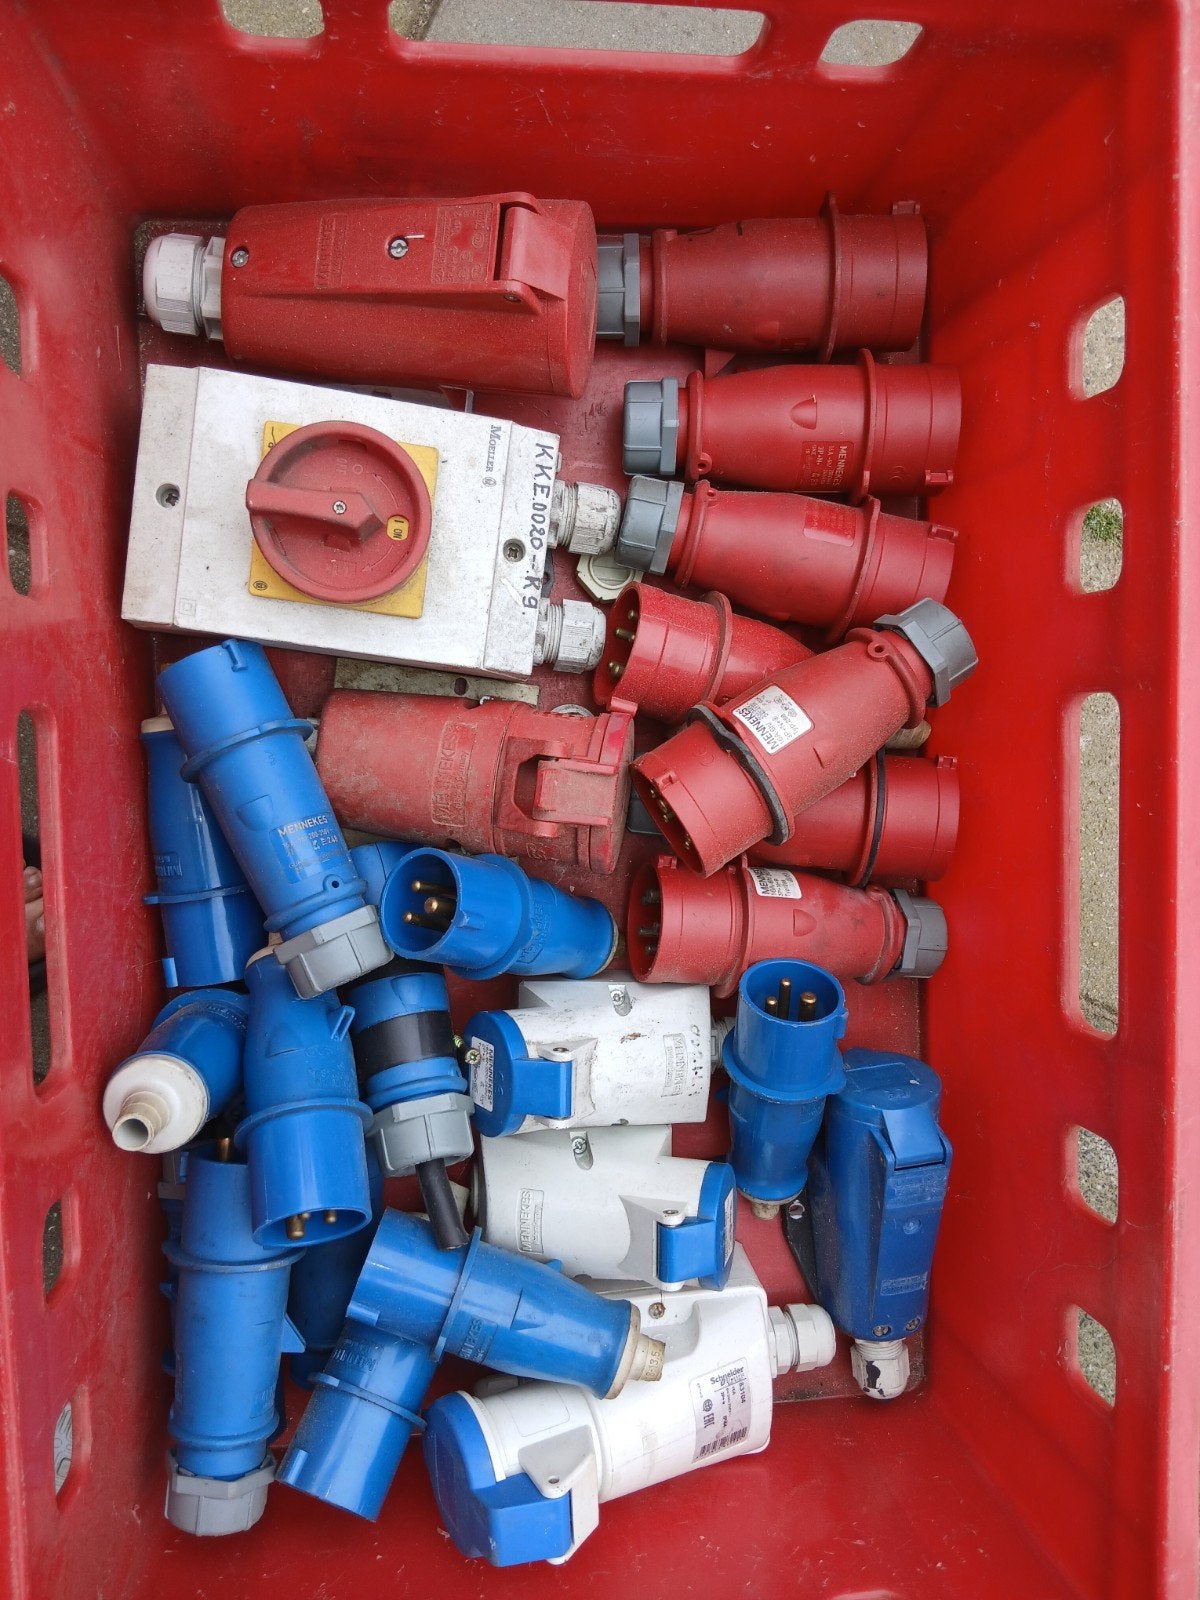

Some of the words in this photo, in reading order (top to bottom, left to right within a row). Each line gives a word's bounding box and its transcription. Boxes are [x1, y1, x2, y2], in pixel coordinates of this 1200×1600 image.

[484, 424, 501, 472] MOELLER
[832, 445, 847, 487] MENNEKES
[392, 528, 402, 539] ON
[738, 706, 779, 750] MENNEKES
[279, 815, 327, 836] MENNEKES
[520, 1191, 532, 1251] MENNEKES
[710, 1366, 743, 1384] Schneider
